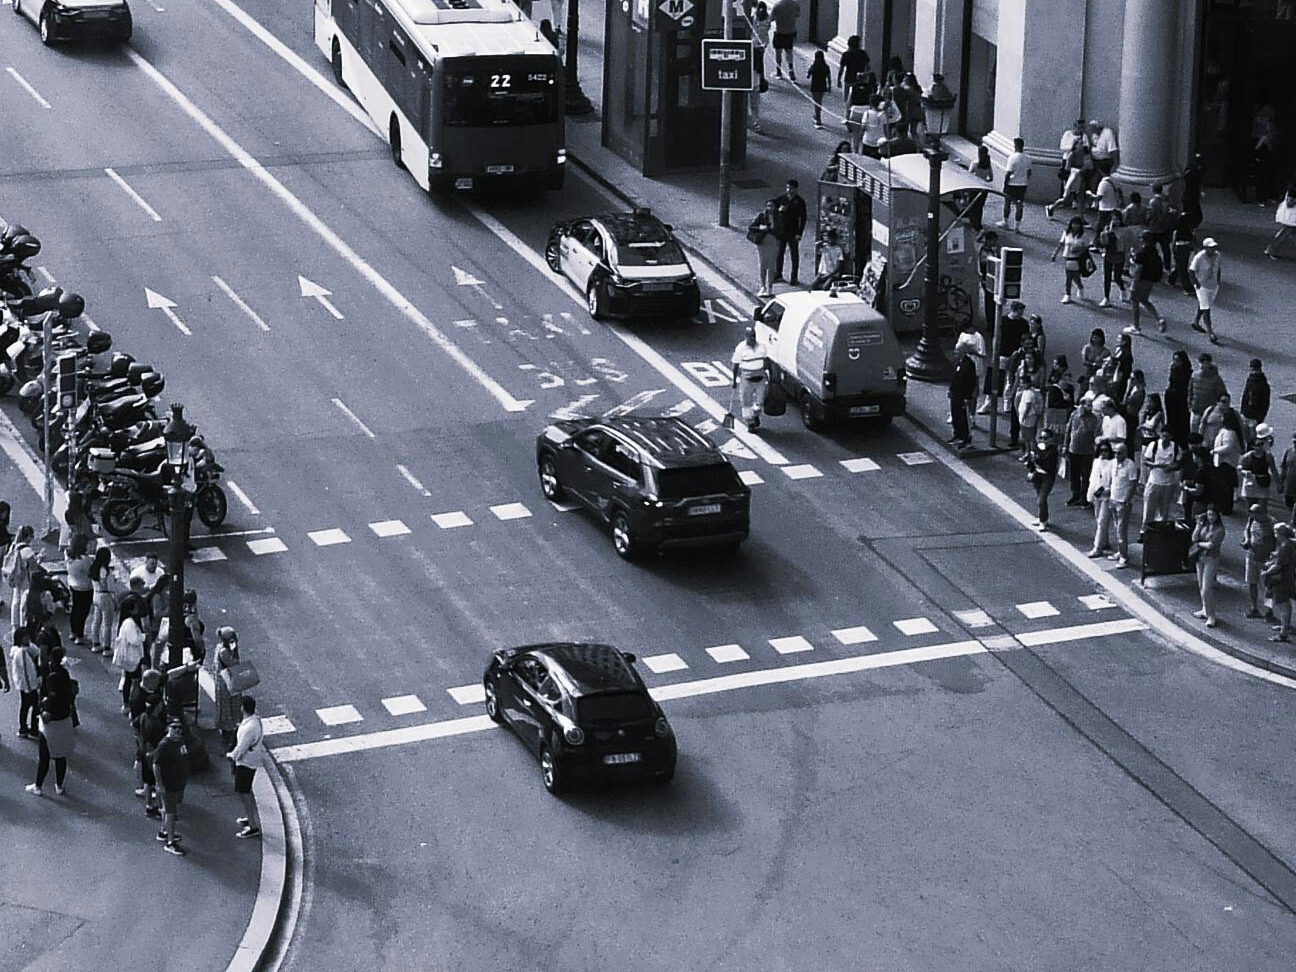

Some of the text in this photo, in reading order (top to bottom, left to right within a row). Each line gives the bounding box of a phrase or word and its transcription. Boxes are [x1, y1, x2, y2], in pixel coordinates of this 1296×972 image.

[668, 0, 684, 14] M
[490, 74, 512, 88] 22
[718, 69, 739, 80] taxi
